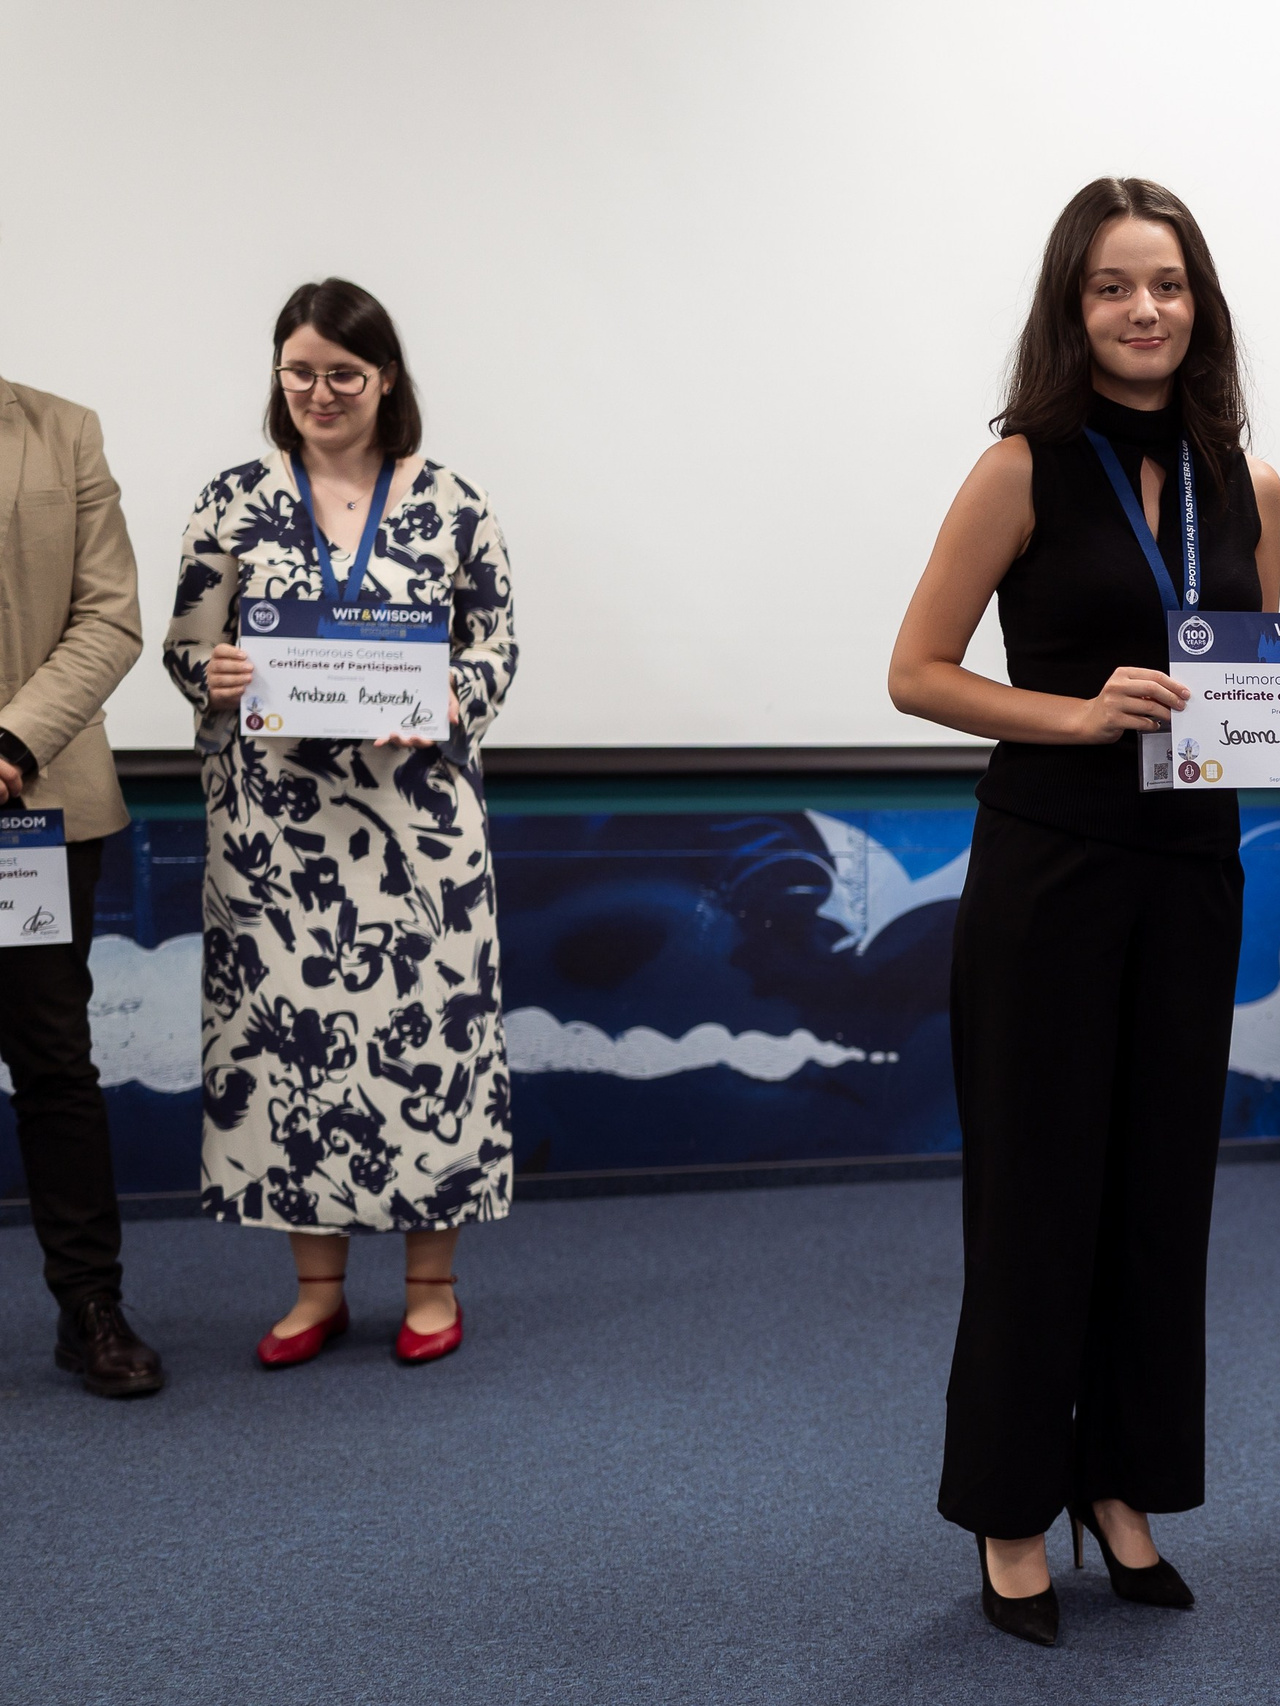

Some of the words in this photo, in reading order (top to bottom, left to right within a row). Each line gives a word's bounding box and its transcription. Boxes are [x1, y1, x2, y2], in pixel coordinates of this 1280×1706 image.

[1181, 440, 1189, 461] CLUB
[1183, 462, 1194, 523] TOASTMASTERS
[1187, 541, 1197, 587] SPOTLIGHT
[332, 607, 433, 623] WIT&WISDOM
[1185, 630, 1207, 640] 100
[287, 647, 353, 659] Humorous
[269, 659, 330, 669] Certificate
[333, 661, 345, 670] of
[348, 662, 422, 674] Participation
[1204, 689, 1274, 701] Certificate
